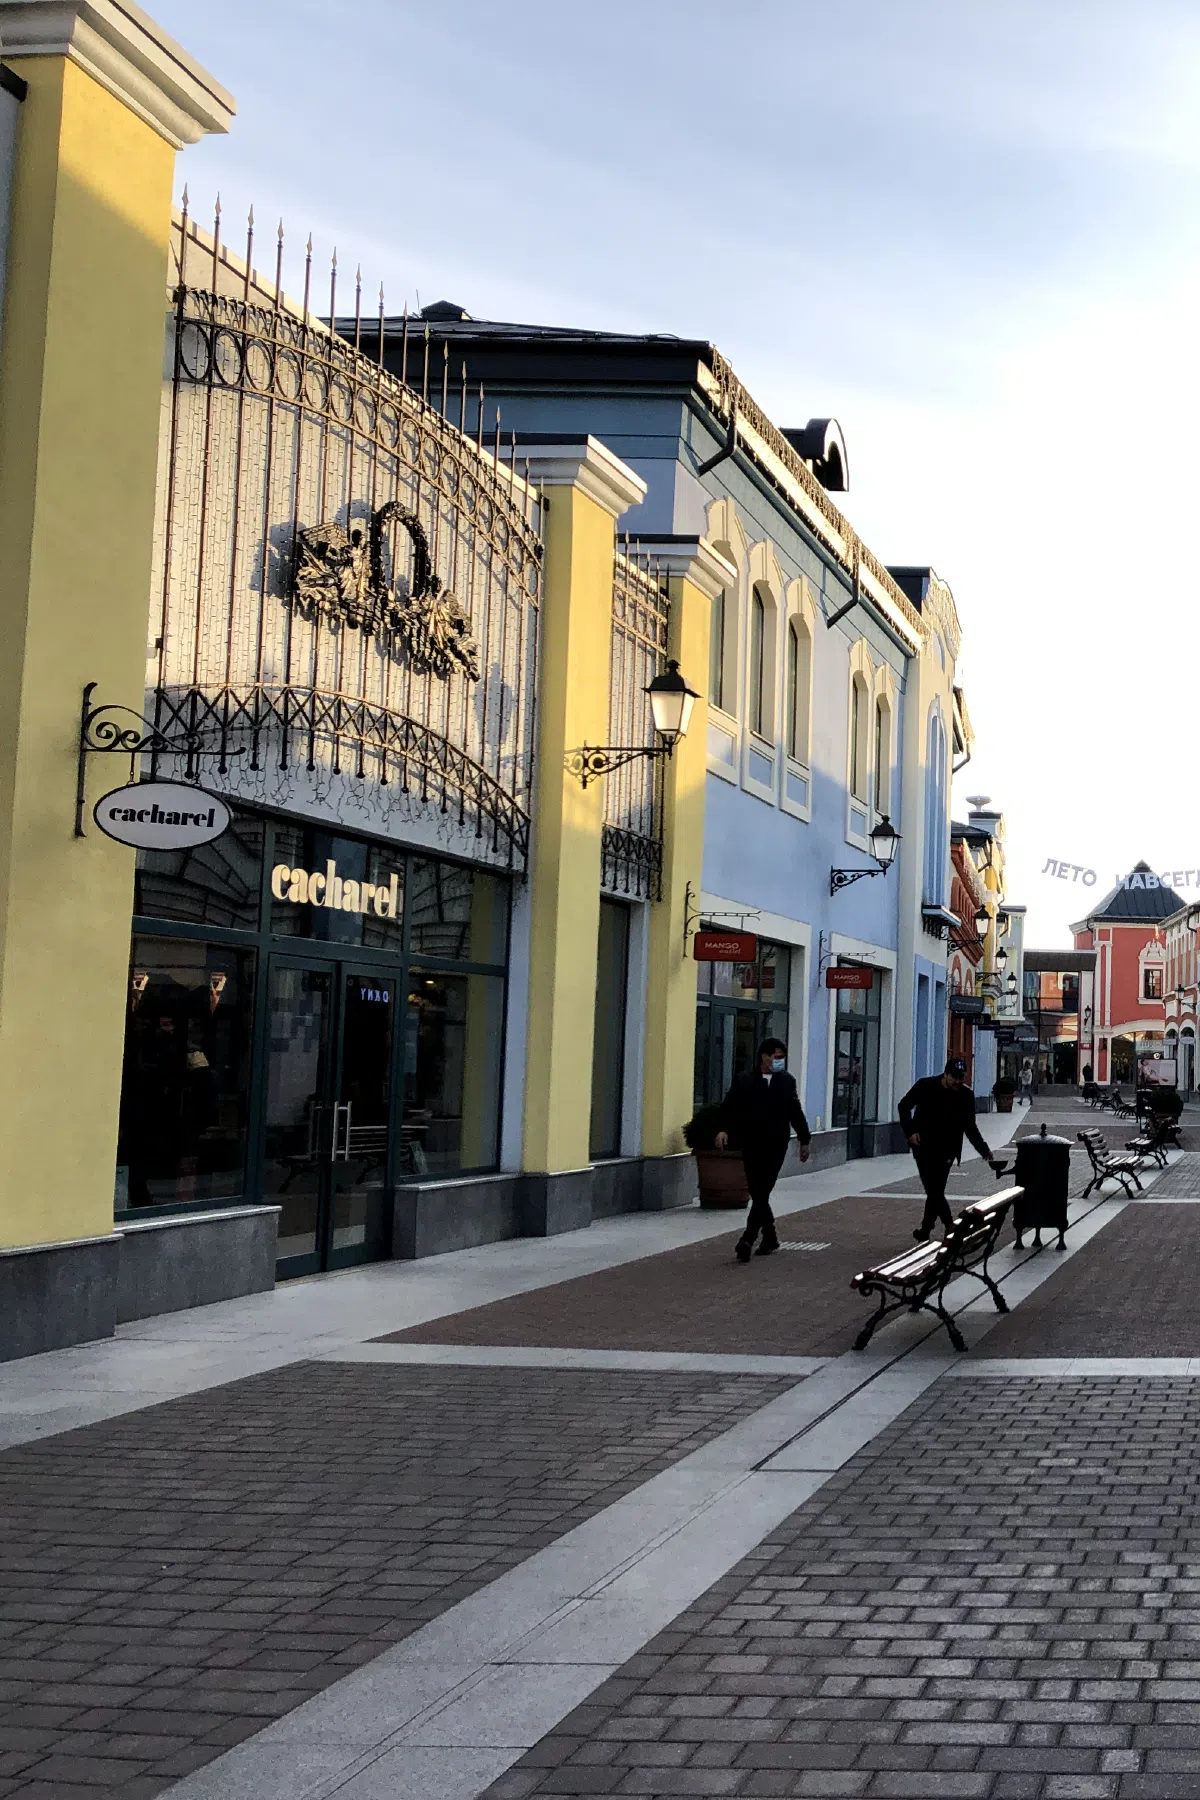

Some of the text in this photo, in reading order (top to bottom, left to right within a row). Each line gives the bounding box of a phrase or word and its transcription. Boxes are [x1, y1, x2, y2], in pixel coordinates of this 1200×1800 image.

[108, 804, 216, 828] cacharel
[1041, 857, 1098, 887] ЛЕТО
[271, 858, 399, 919] cacharel
[704, 942, 740, 950] MANGO
